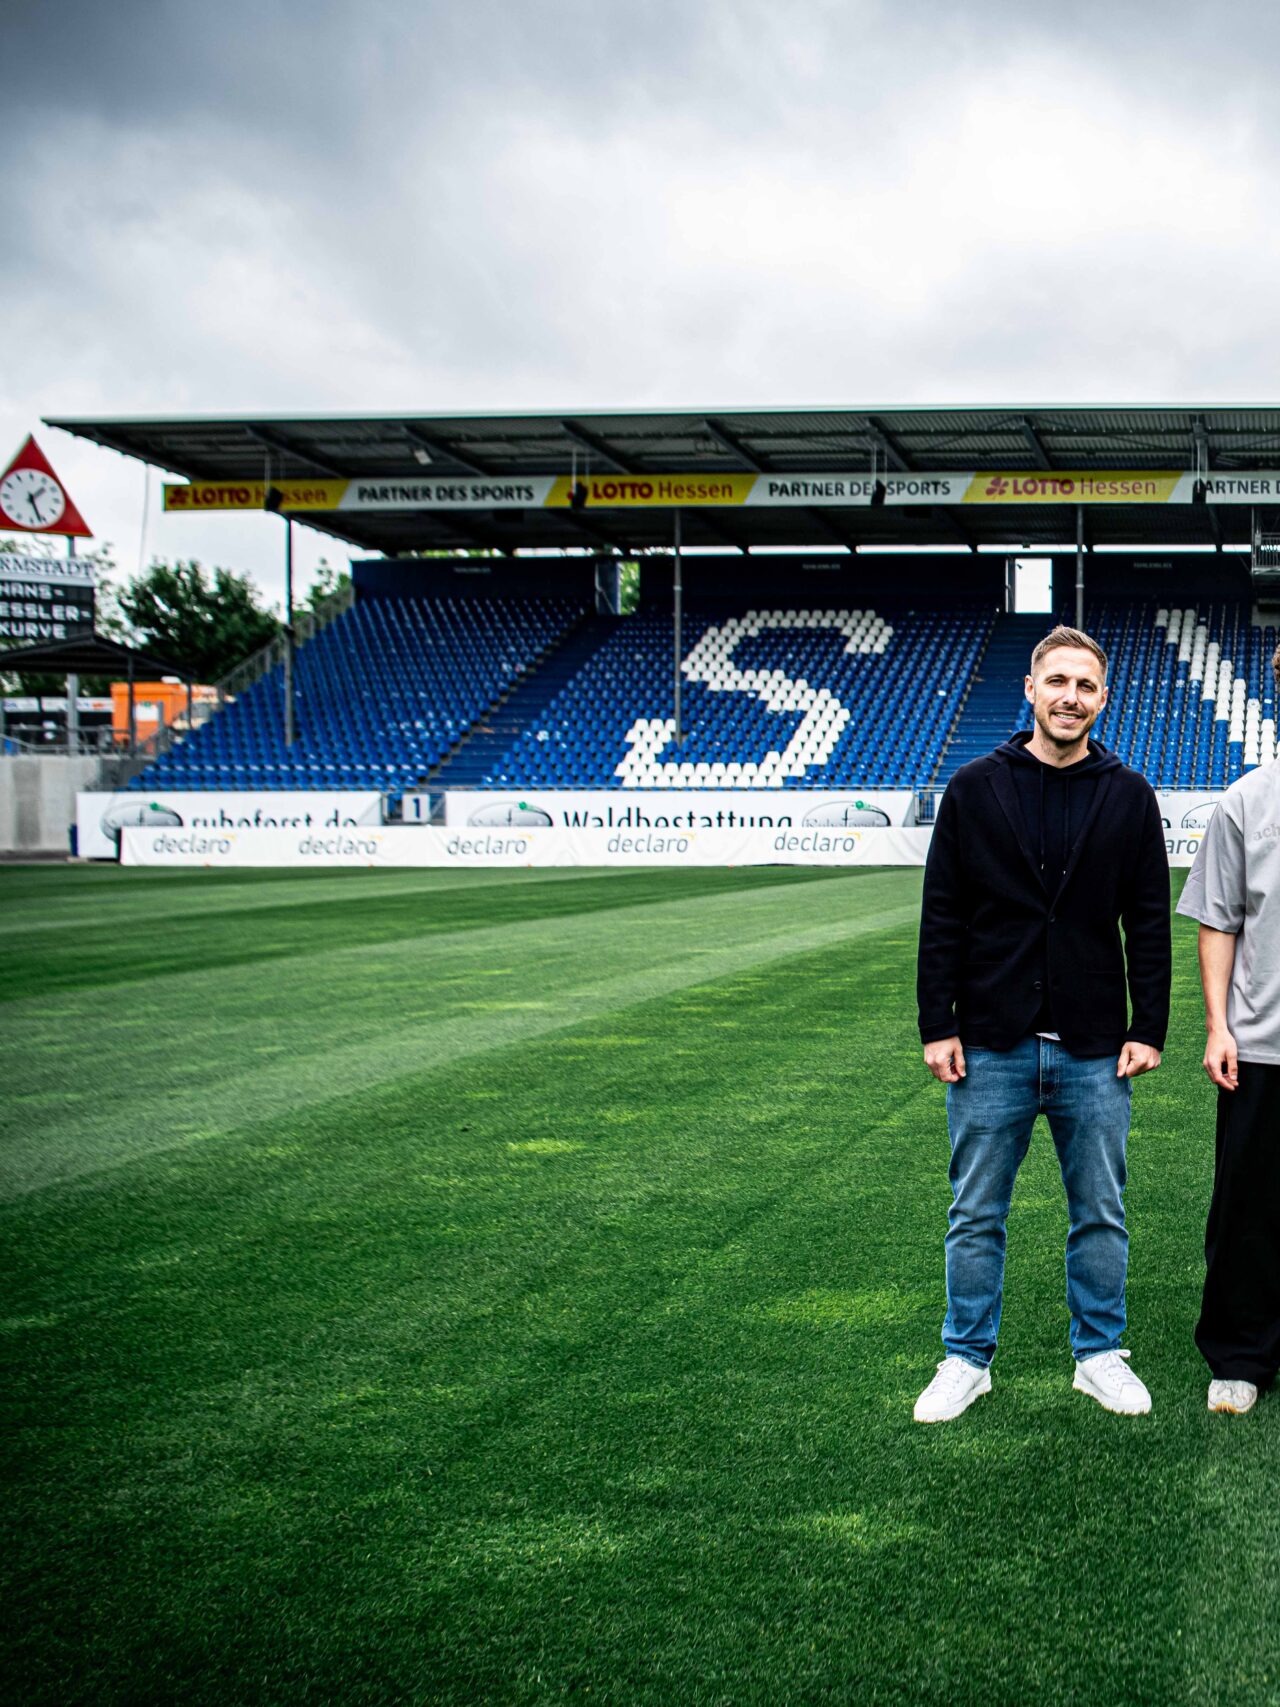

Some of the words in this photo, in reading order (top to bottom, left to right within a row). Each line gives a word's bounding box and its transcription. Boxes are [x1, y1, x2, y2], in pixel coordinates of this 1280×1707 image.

[193, 488, 250, 504] LOTTO
[255, 486, 328, 503] Hssen
[357, 486, 432, 500] PARTNER
[436, 486, 467, 500] DES
[471, 485, 534, 500] SPORTS
[593, 482, 654, 499] LOTTO
[659, 481, 733, 499] Hessen
[769, 482, 845, 496] PARTNER
[887, 481, 951, 496] SPORTS
[1013, 479, 1075, 496] LOTTO
[1081, 478, 1156, 495] Hessen
[1206, 480, 1270, 494] ARTNER
[411, 797, 421, 818] 1
[153, 833, 231, 854] declaro
[298, 834, 377, 854] declaro
[446, 834, 527, 855] declaro
[607, 833, 688, 853] declaro
[774, 832, 855, 852] declaro
